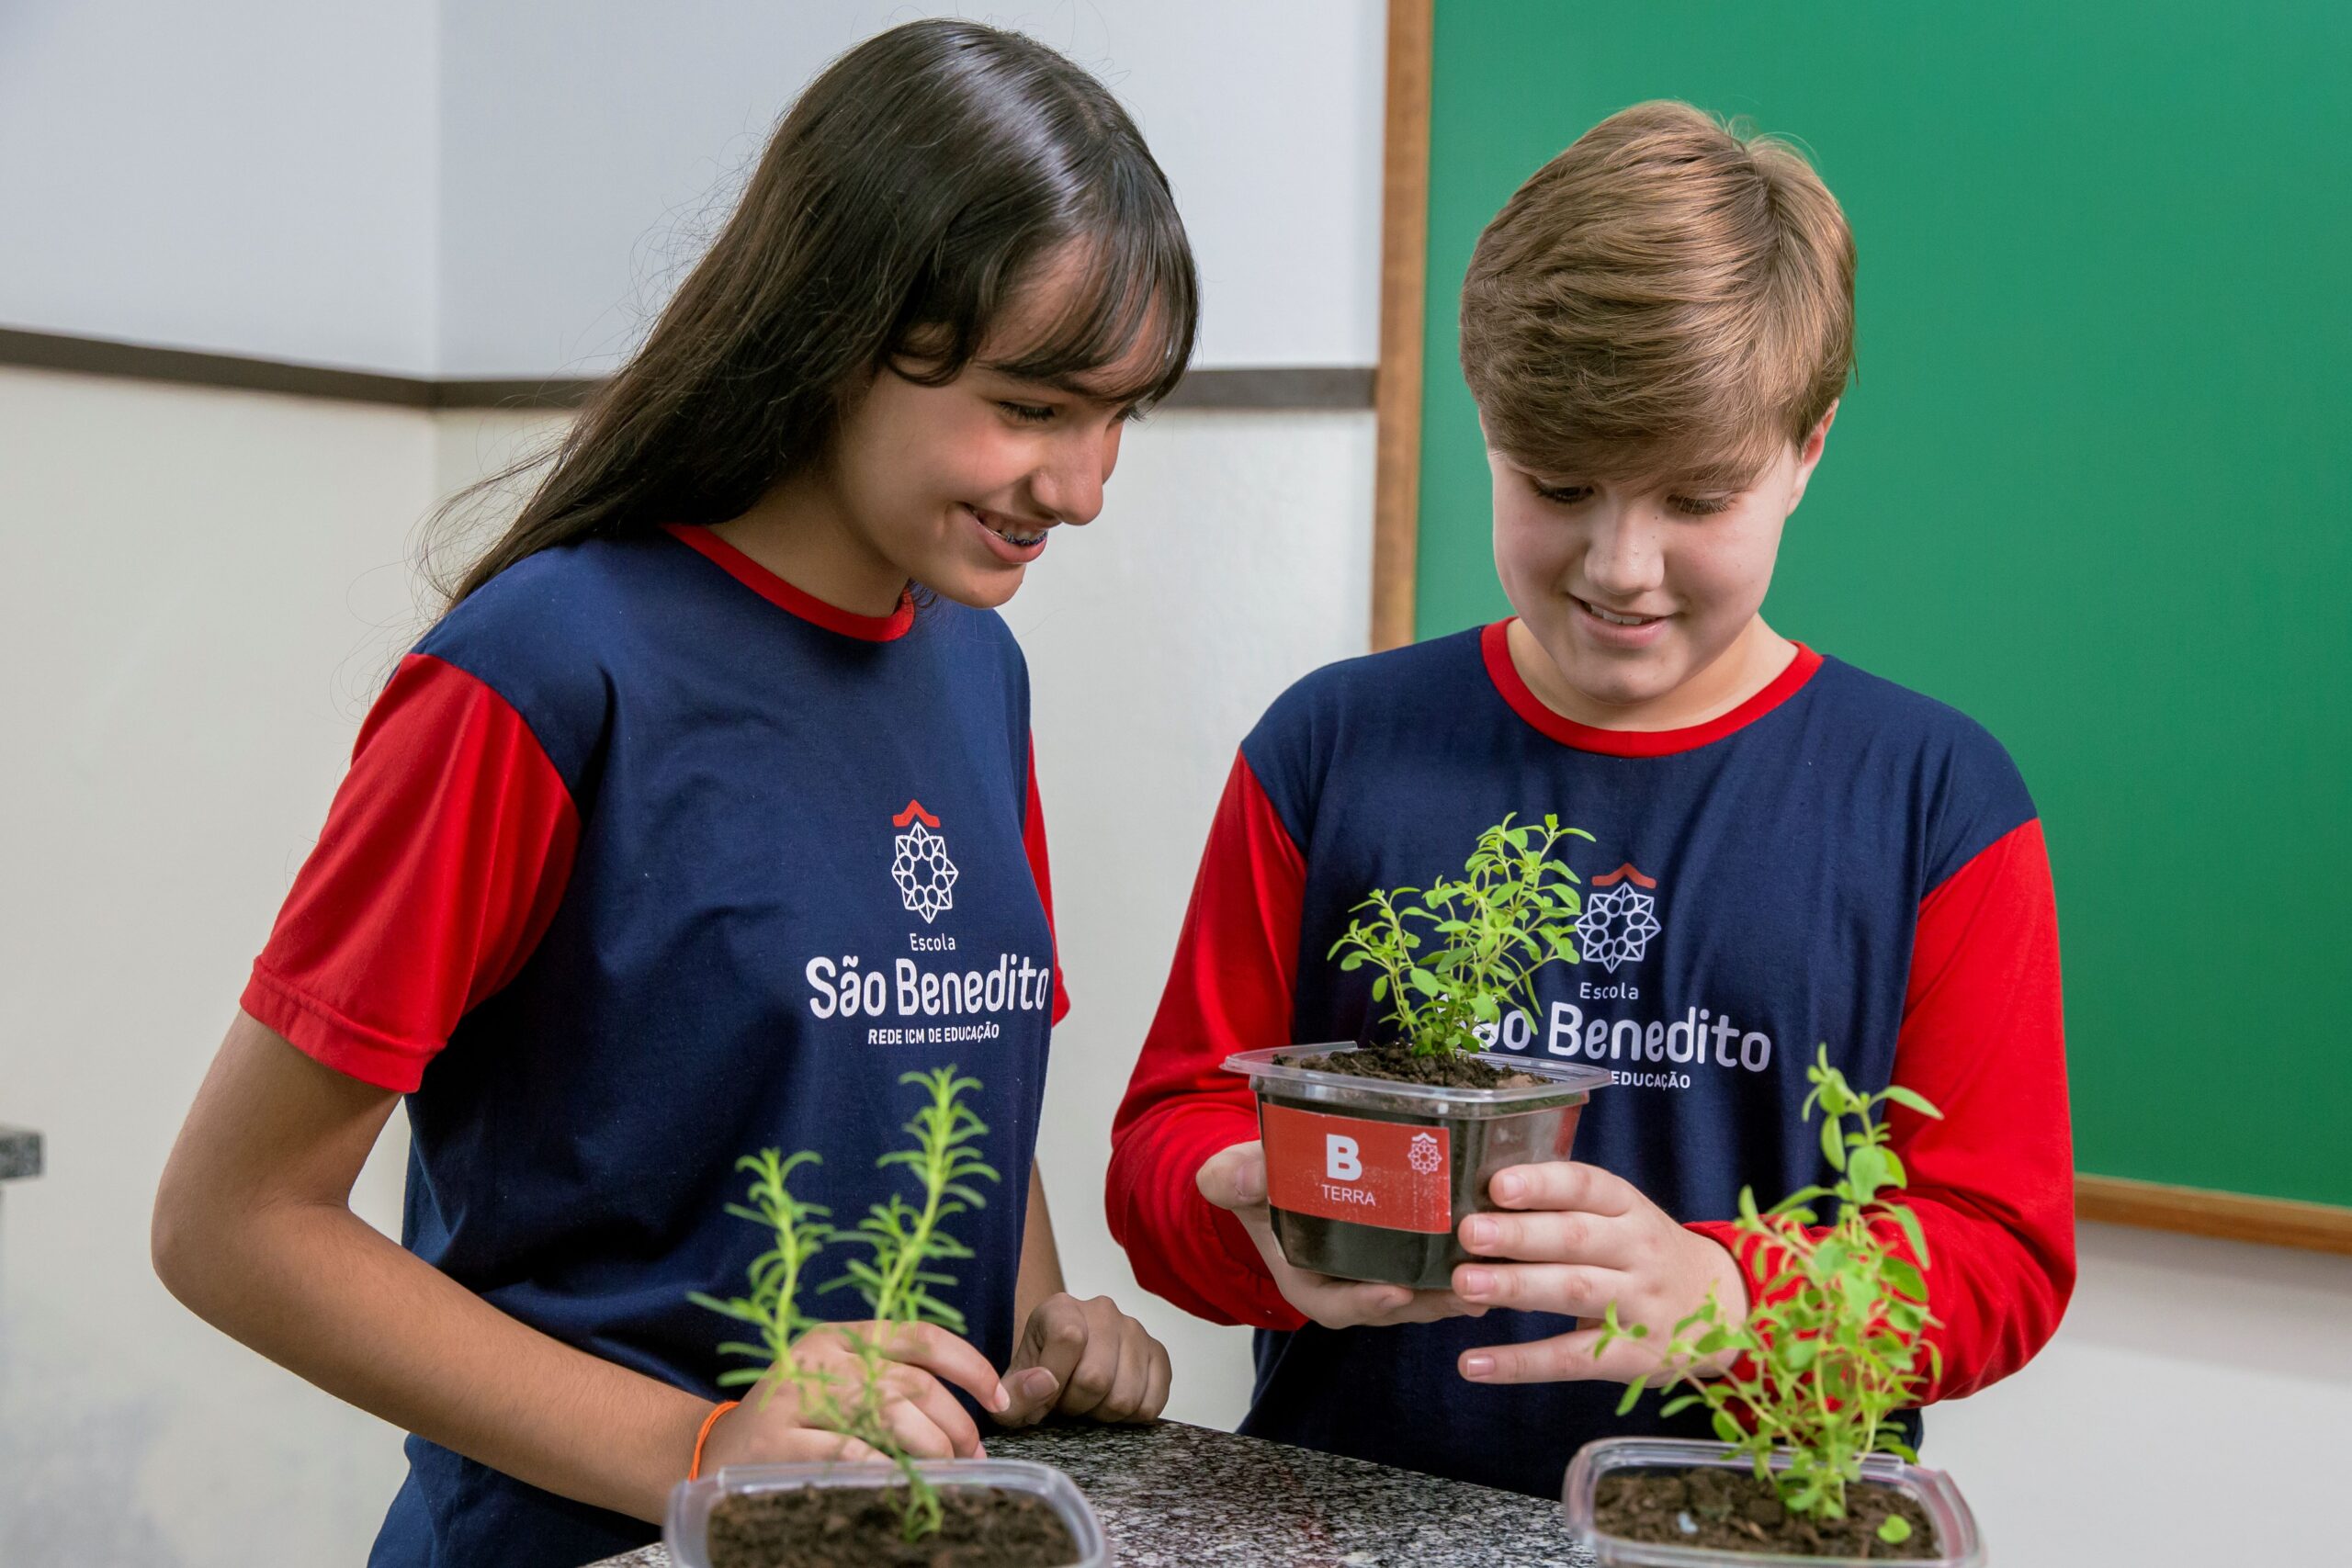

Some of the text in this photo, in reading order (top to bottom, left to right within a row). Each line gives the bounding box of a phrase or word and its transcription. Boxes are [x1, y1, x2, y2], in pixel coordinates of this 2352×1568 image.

[910, 933, 956, 951] Escola
[806, 953, 1049, 1019] São Benedito
[1580, 982, 1639, 999] Escola
[867, 1021, 1000, 1044] REDE ICM DE EDUCAÇÃO
[1548, 1001, 1771, 1072] Benedito
[1611, 1070, 1690, 1090] EDUCAÇÃO
[1326, 1134, 1363, 1181] B
[1321, 1184, 1376, 1206] TERRA
